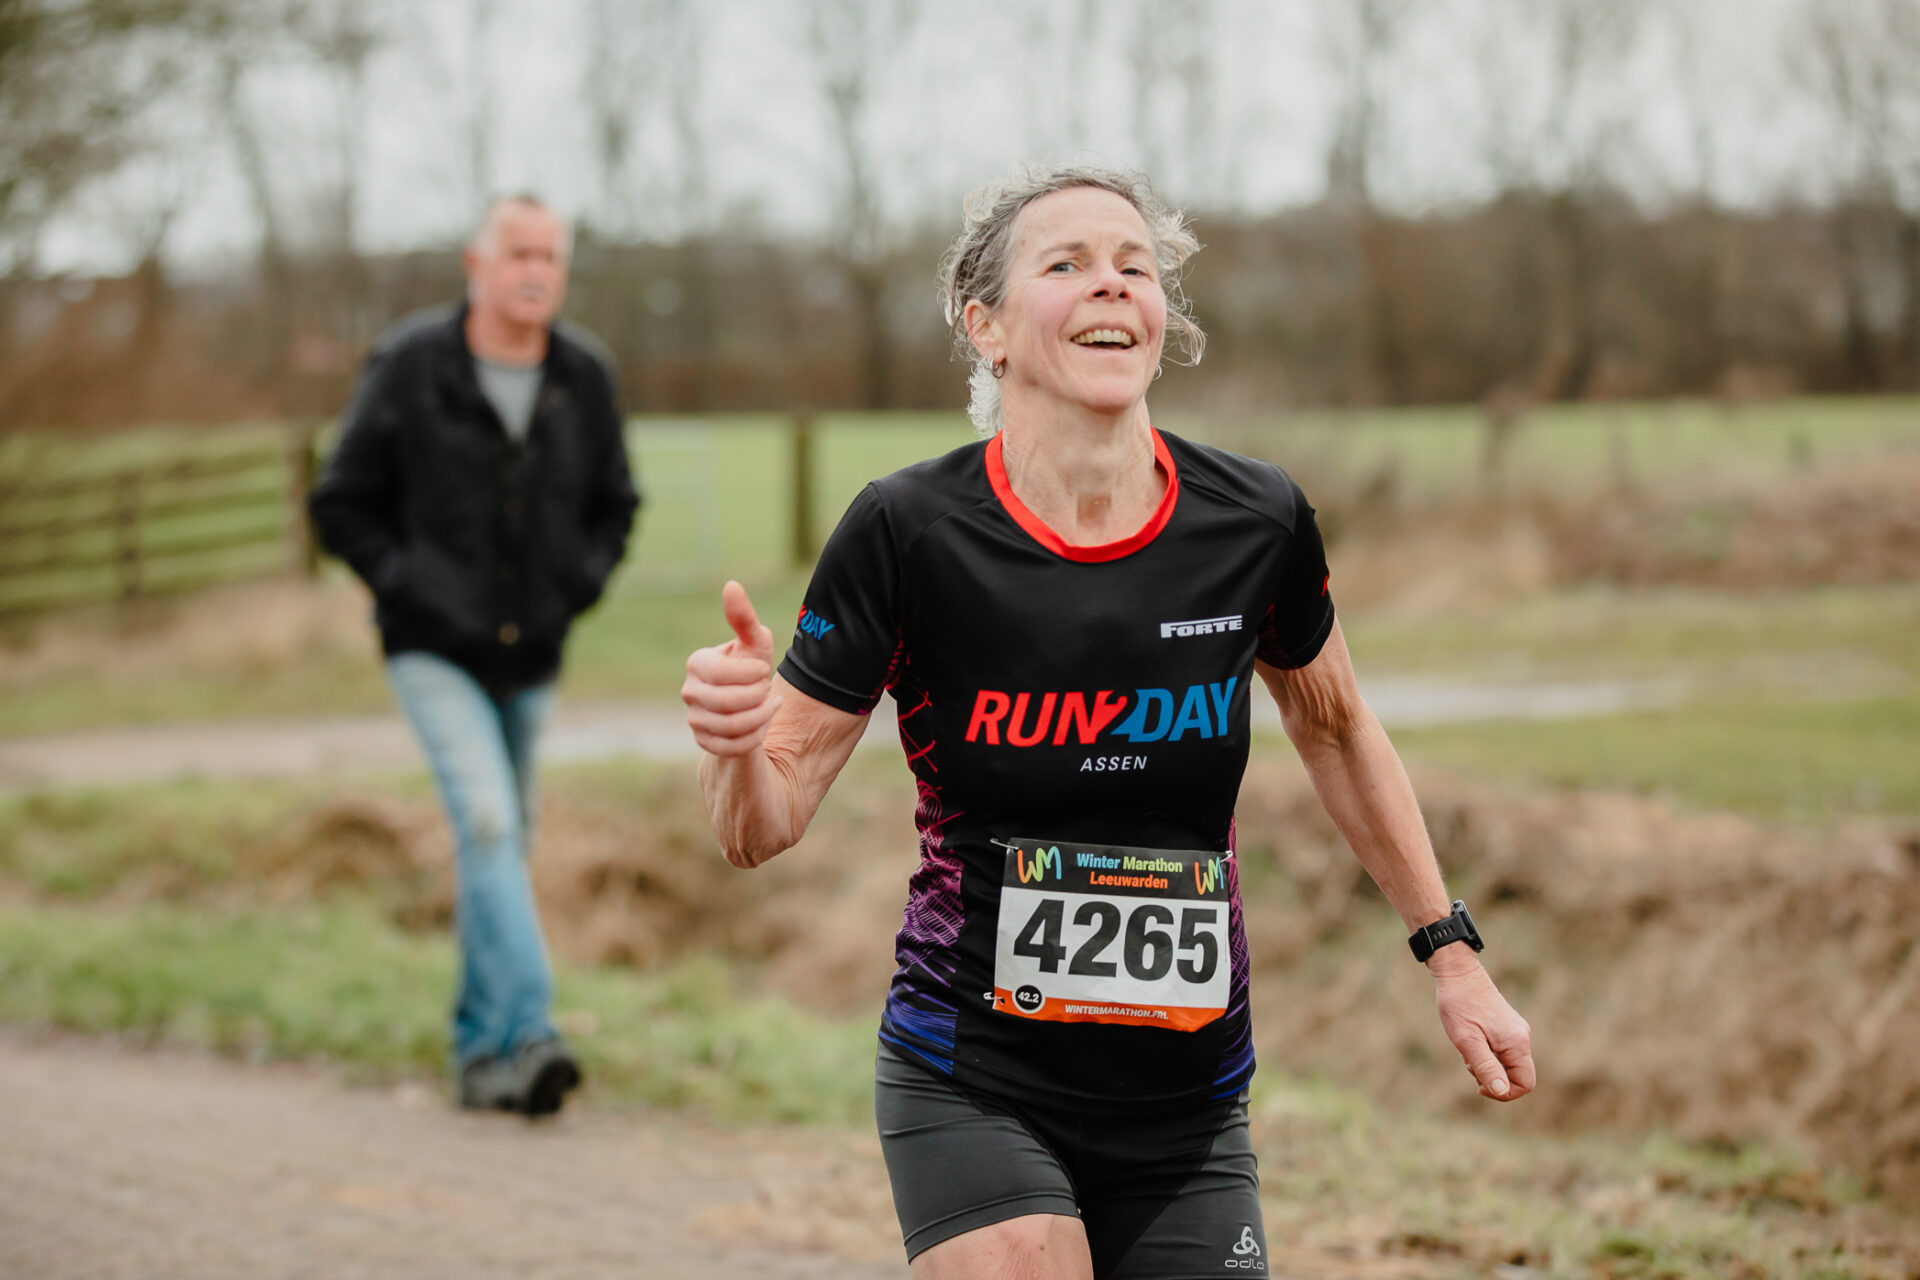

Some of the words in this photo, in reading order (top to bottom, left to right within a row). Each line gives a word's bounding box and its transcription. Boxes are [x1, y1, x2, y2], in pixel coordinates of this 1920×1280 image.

[1160, 614, 1243, 639] FORTE
[964, 676, 1238, 747] RUN2DAY
[1080, 755, 1148, 772] ASSEN
[1076, 852, 1121, 869] Winter
[1122, 855, 1183, 873] Marathon
[1089, 871, 1169, 889] Leeuwarden
[1013, 898, 1219, 984] 4265
[1017, 990, 1040, 1004] 42.2
[1064, 1003, 1169, 1021] WINTERMARATHON.FRL
[1224, 1257, 1265, 1270] odlo
